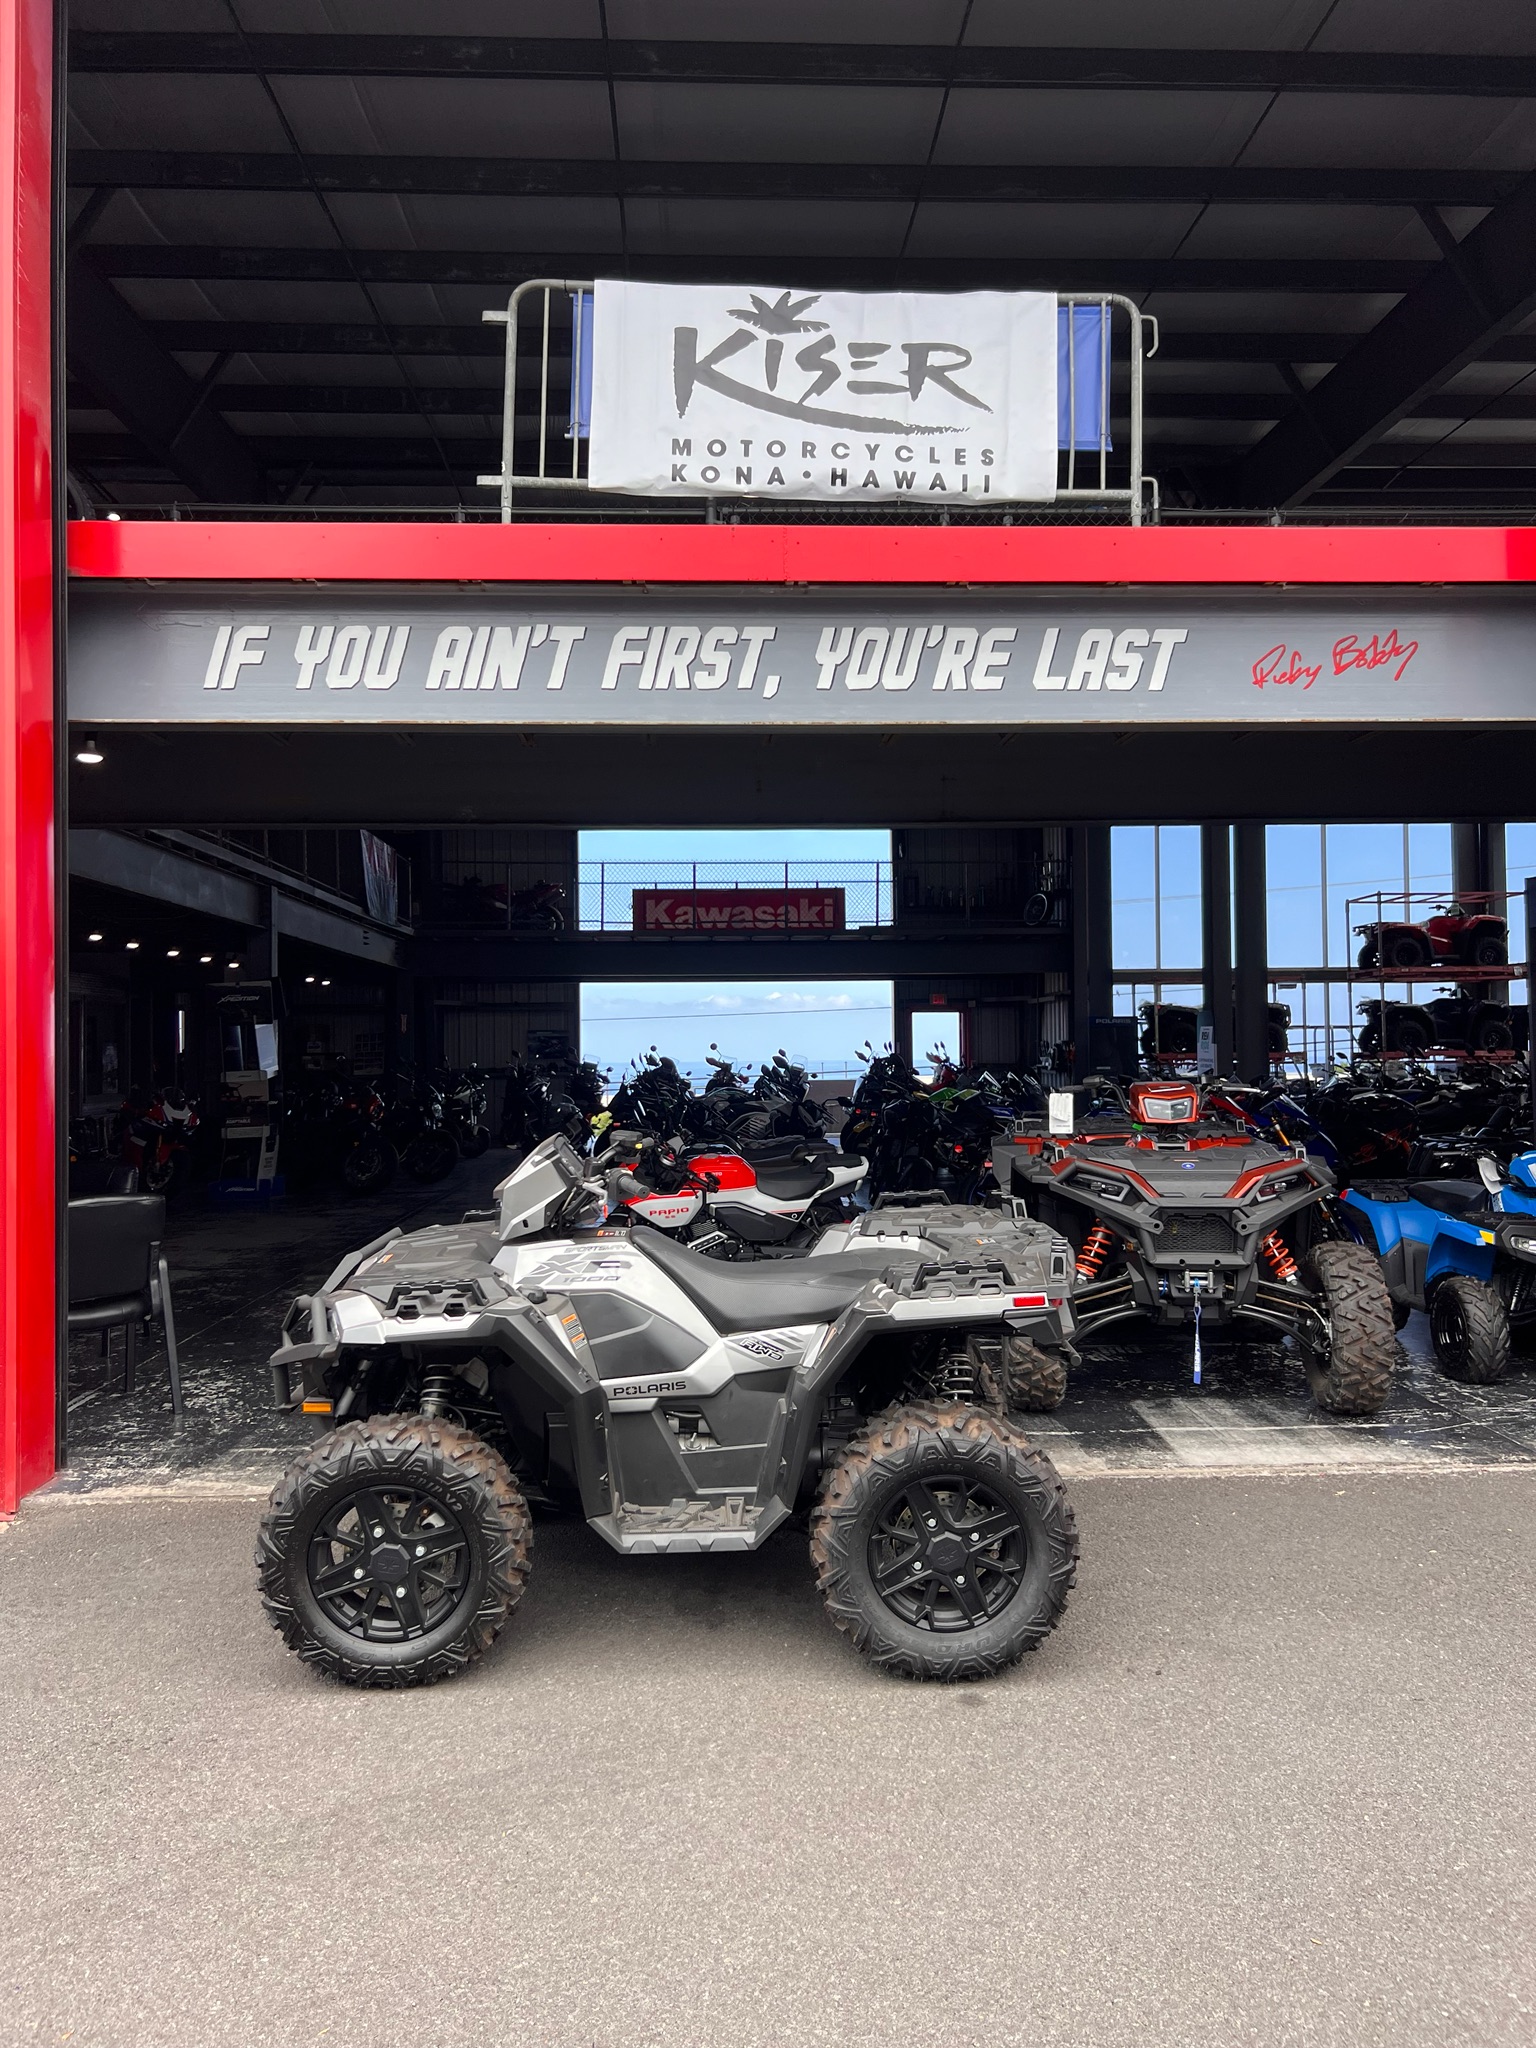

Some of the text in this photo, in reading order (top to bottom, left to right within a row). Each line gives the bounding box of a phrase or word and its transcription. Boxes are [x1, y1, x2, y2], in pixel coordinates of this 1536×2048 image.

[673, 326, 994, 435] KISER
[671, 438, 995, 467] MOTORCYCLES
[671, 463, 991, 493] KONA HAWAII
[203, 624, 1189, 698] IF YOU AIN'T FIRST, YOU'RE LAST
[1332, 629, 1420, 682] Bobby
[645, 898, 834, 930] Kawasaki
[649, 1206, 689, 1217] PAPIO
[563, 1244, 628, 1254] SPORTSMAN
[563, 1275, 621, 1284] 1000
[613, 1381, 687, 1396] POLARIS
